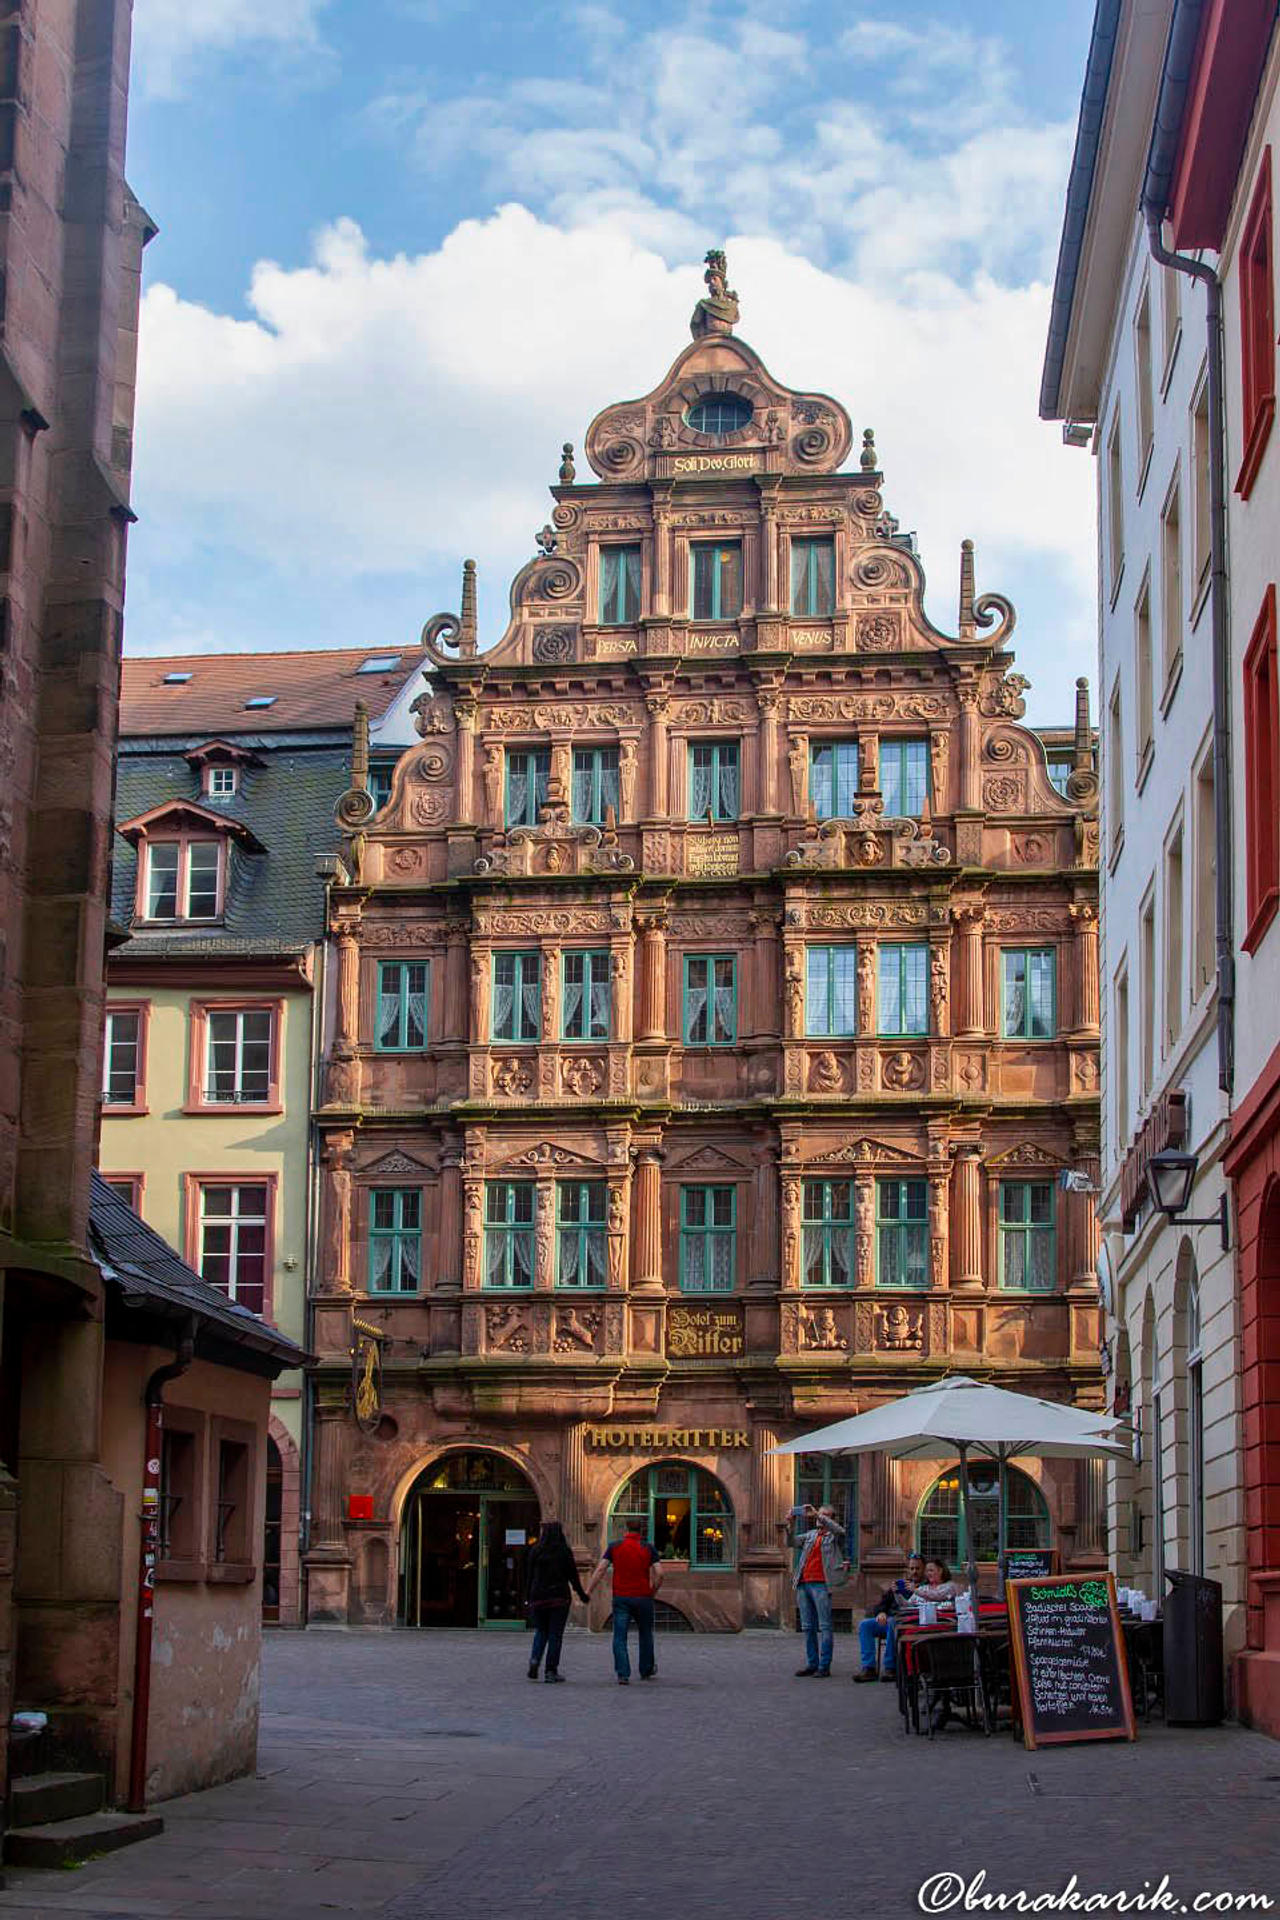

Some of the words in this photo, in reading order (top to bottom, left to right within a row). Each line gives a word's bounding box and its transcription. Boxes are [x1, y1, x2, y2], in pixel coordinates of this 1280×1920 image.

[690, 634, 740, 649] INVICTA
[792, 631, 832, 646] VENUS
[598, 640, 638, 653] PERSTA
[669, 1327, 743, 1355] Ritter
[592, 1429, 664, 1447] HOTEL
[667, 1429, 751, 1447] RITTER
